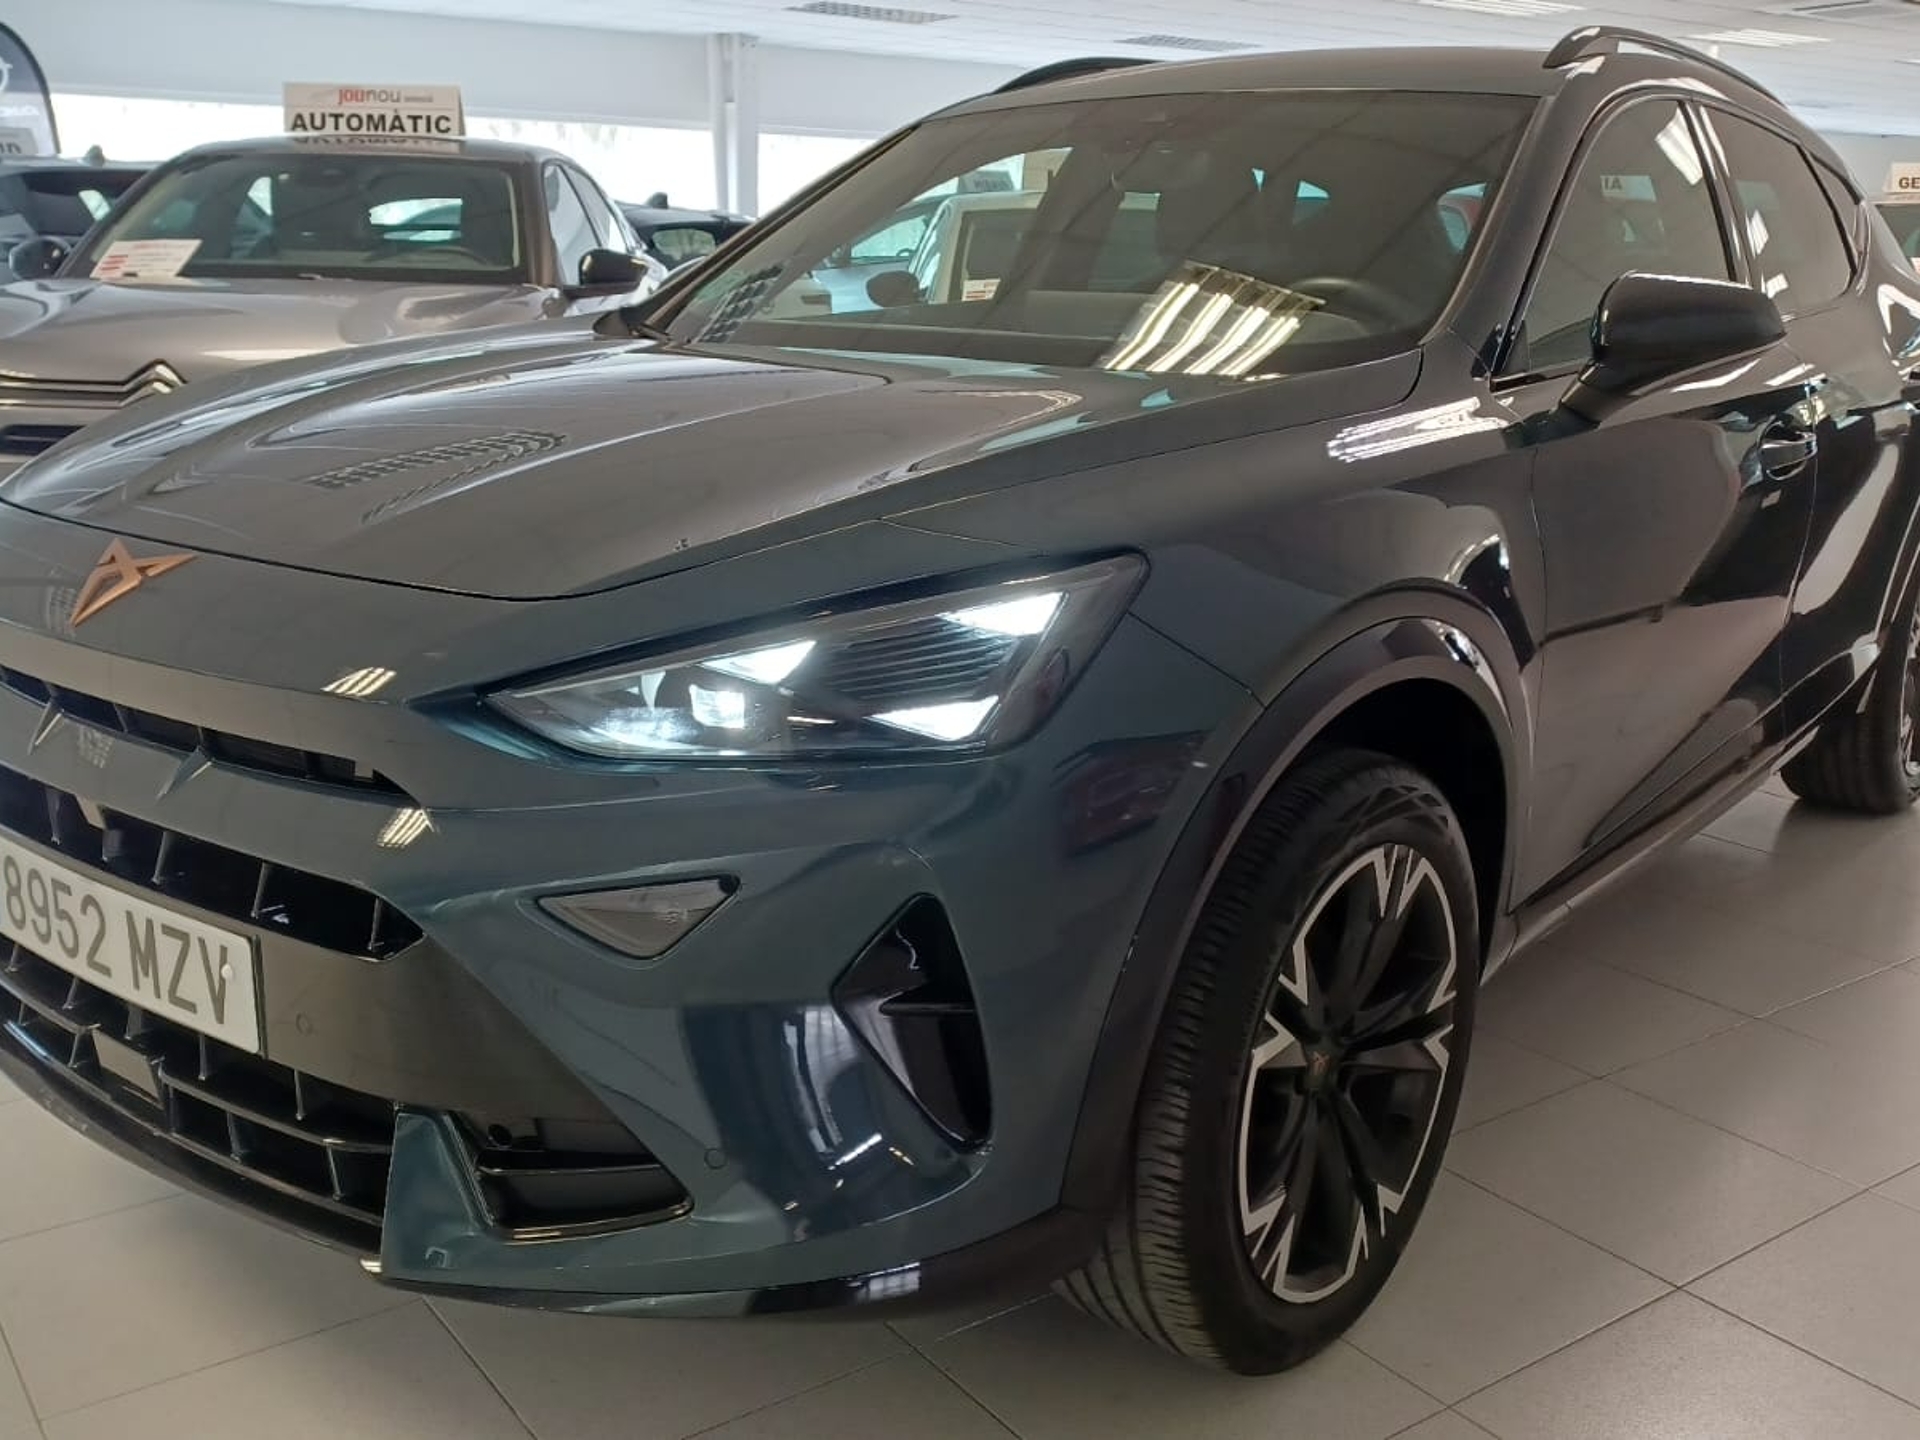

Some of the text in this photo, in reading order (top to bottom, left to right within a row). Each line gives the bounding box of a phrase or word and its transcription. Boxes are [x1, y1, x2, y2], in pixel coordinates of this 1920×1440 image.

[290, 109, 452, 134] AUTOMÀTIC
[4, 855, 228, 1025] 8952 MZV
